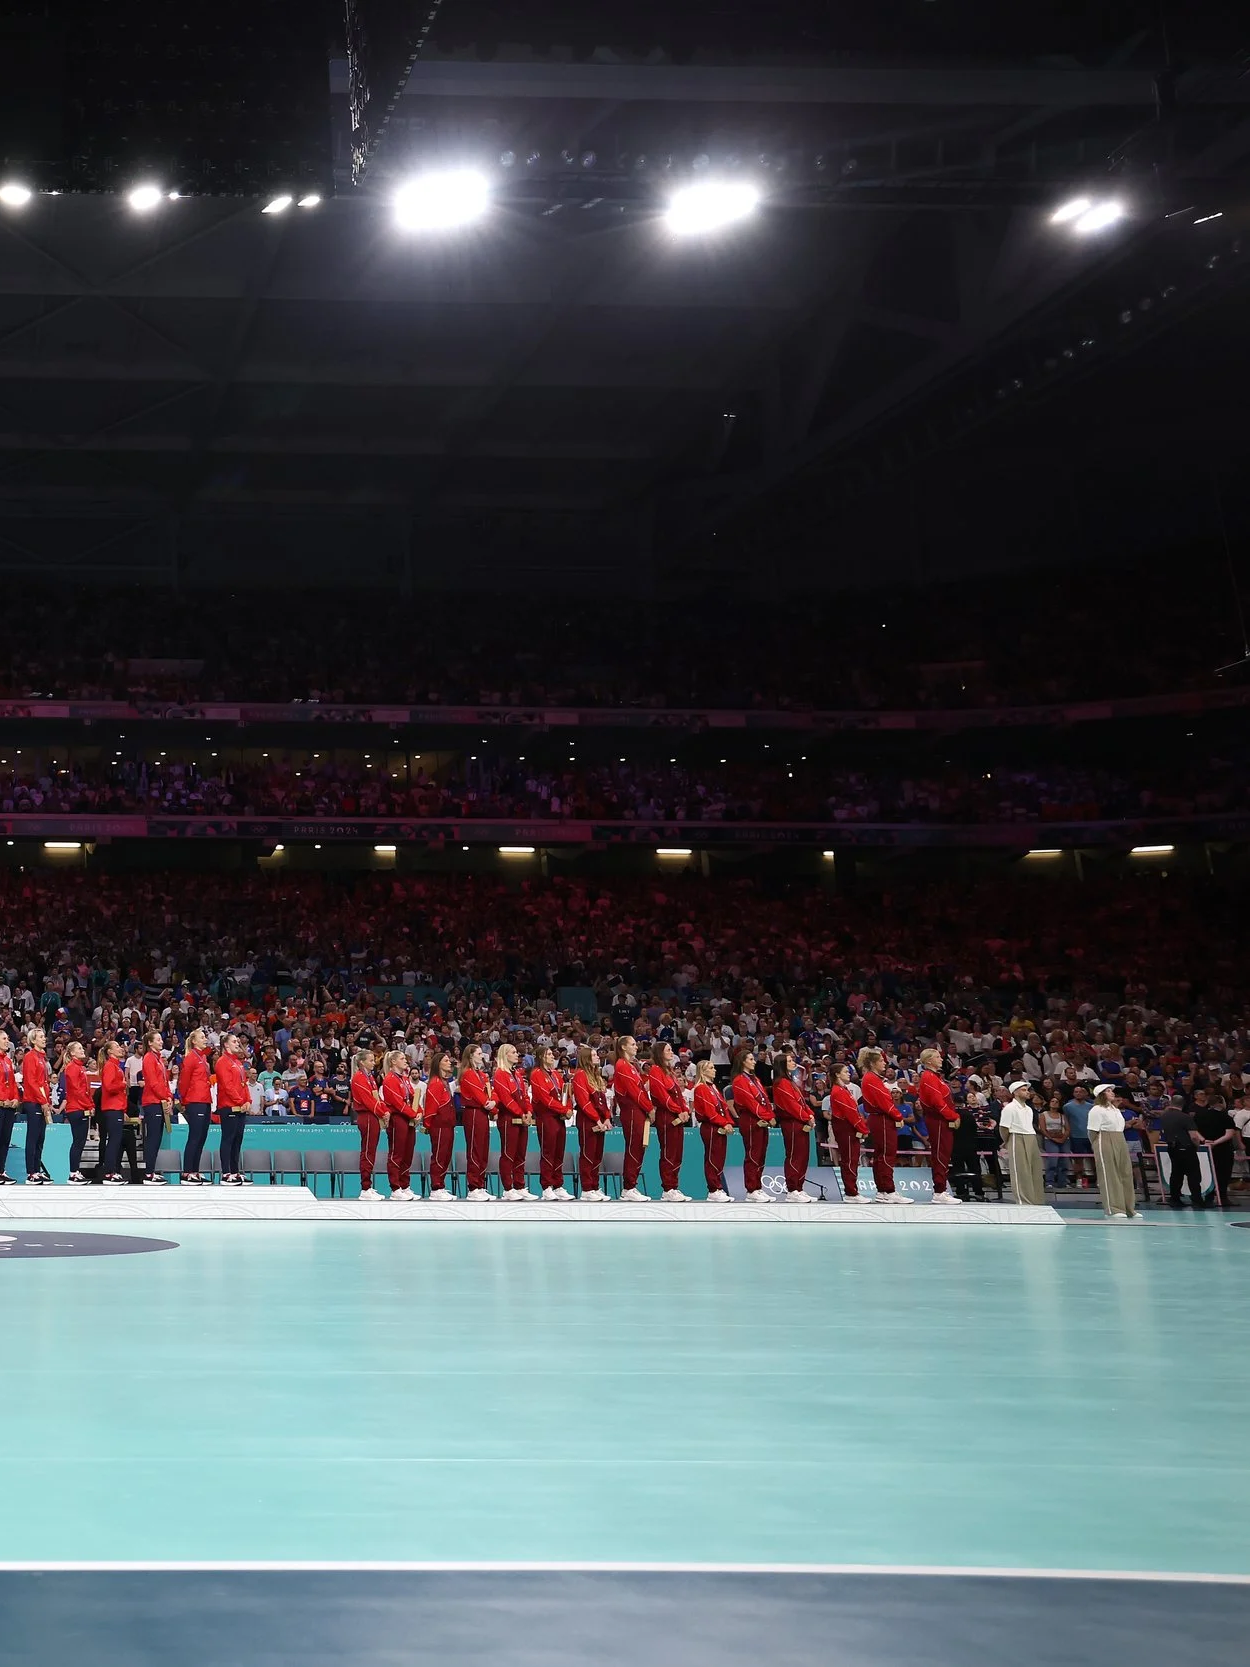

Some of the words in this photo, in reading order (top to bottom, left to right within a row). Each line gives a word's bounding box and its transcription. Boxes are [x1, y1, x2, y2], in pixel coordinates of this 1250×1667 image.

[294, 826, 325, 834] PARIS
[329, 826, 359, 834] 2024
[899, 1181, 932, 1191] 202
